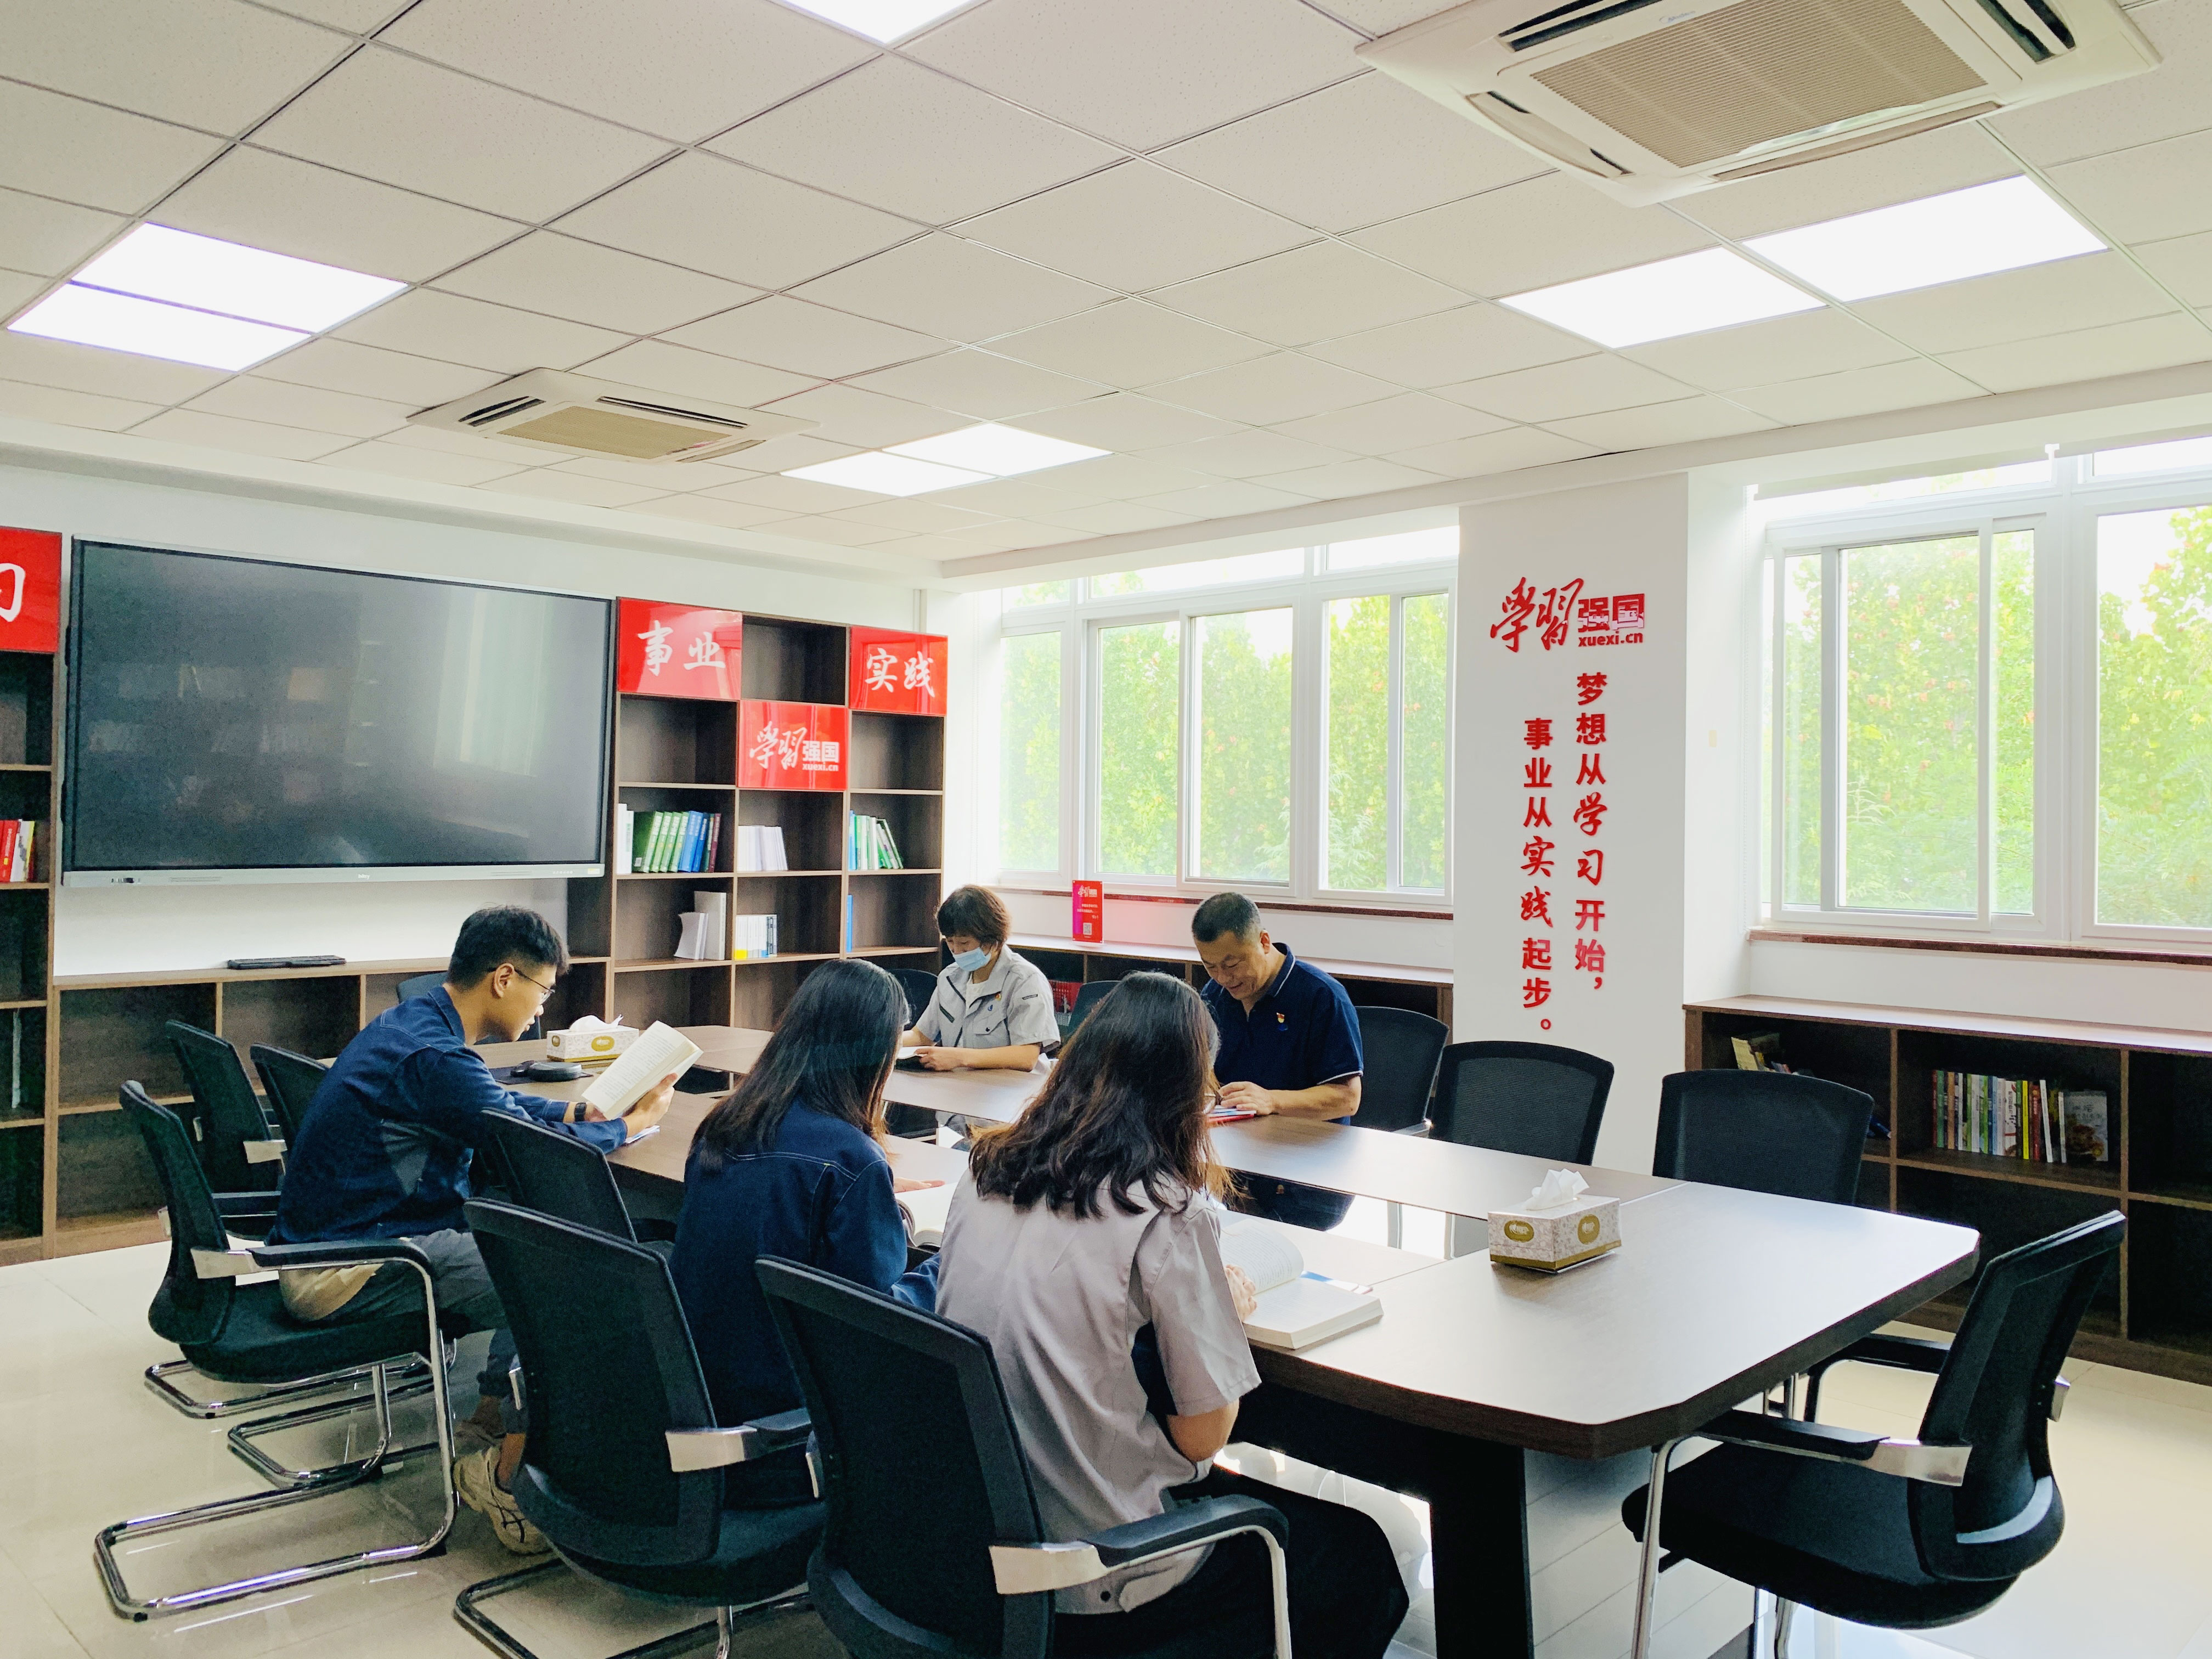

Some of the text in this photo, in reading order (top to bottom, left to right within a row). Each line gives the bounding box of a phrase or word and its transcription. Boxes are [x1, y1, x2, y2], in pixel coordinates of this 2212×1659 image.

[637, 620, 726, 676] 事业
[1578, 631, 1644, 647] xuexi.cn
[865, 647, 935, 698] 实践
[802, 763, 839, 772] xuexi.cn
